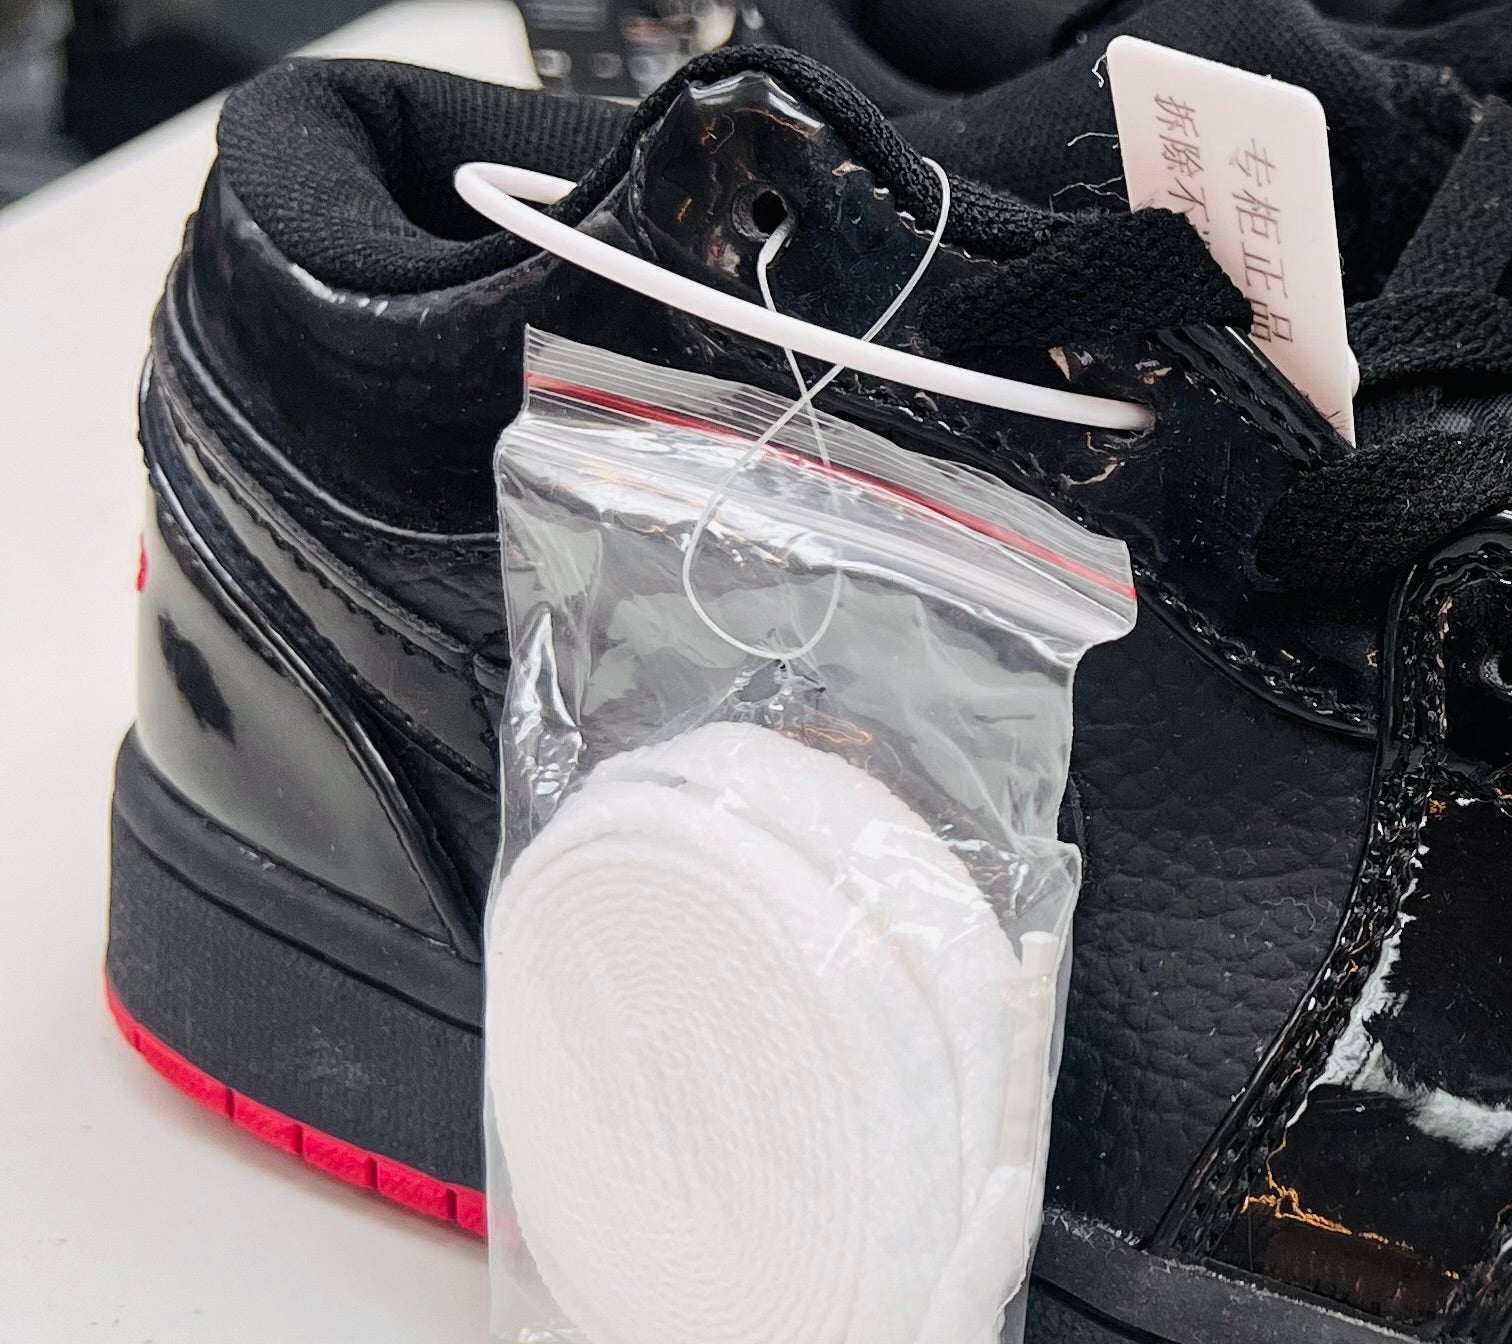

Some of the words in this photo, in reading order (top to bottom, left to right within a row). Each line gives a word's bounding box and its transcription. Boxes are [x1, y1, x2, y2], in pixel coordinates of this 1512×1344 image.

[1153, 93, 1212, 249] 拆除不
[1231, 137, 1294, 344] 专柜正品
